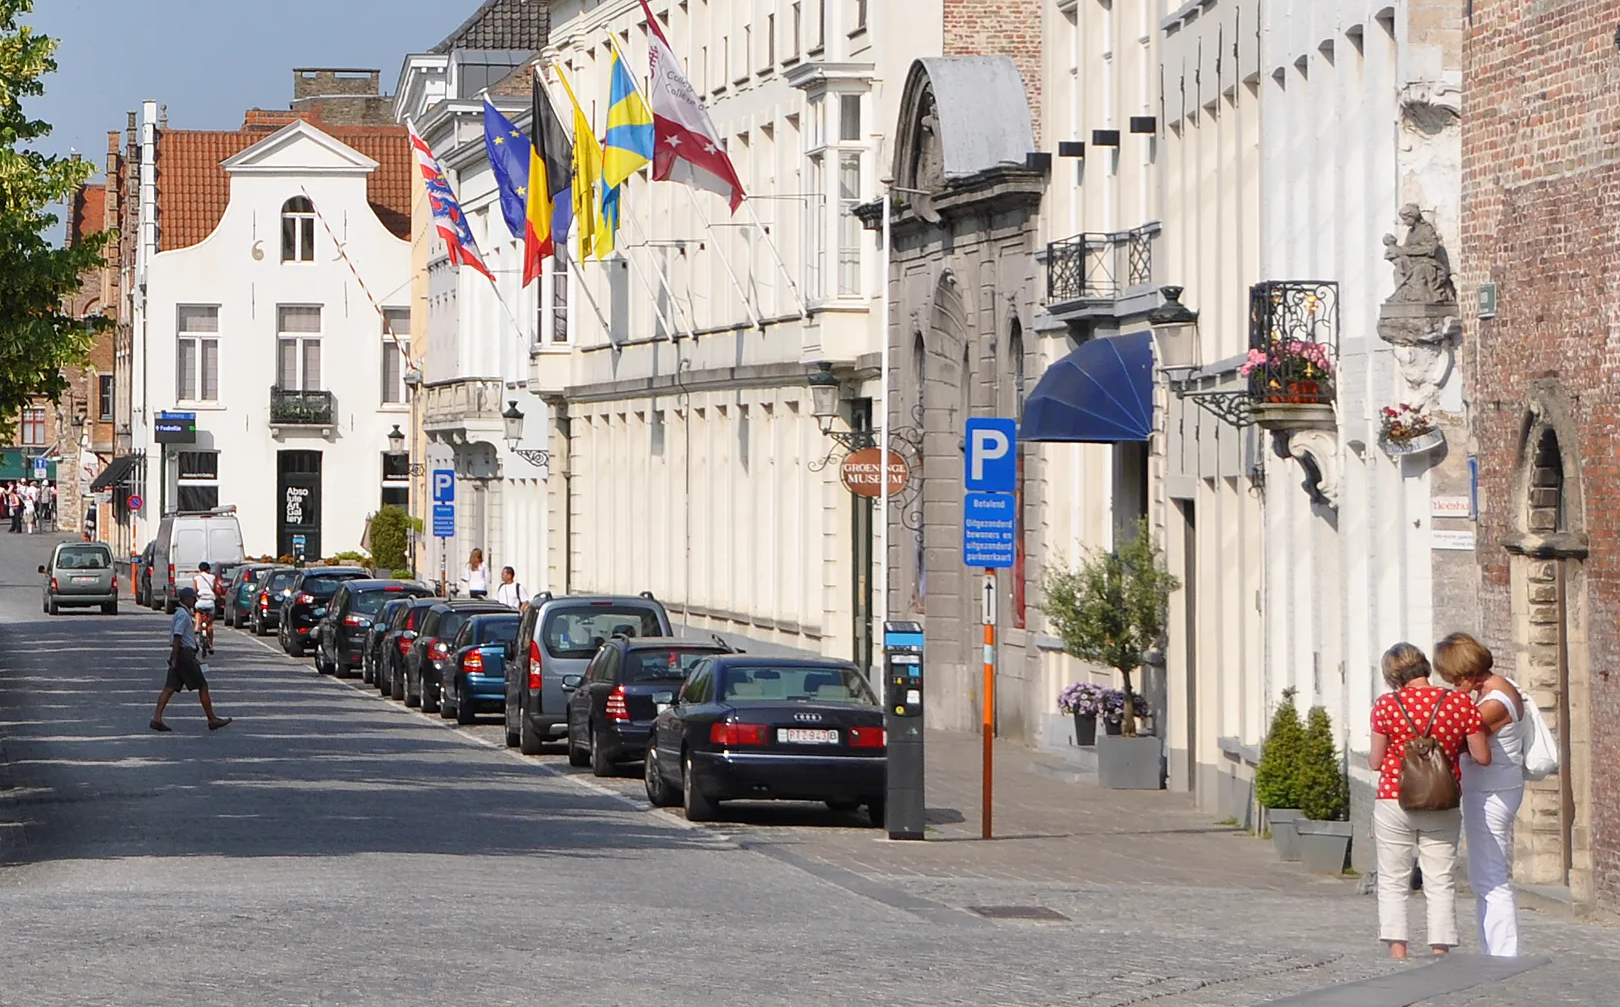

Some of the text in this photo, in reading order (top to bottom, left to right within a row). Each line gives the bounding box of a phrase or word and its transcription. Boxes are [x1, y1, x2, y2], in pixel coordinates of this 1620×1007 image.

[971, 429, 1010, 480] P
[844, 463, 907, 473] GROENNGE
[435, 474, 452, 498] P
[286, 487, 309, 497] Abso
[286, 502, 300, 510] Art
[286, 507, 302, 515] Gal
